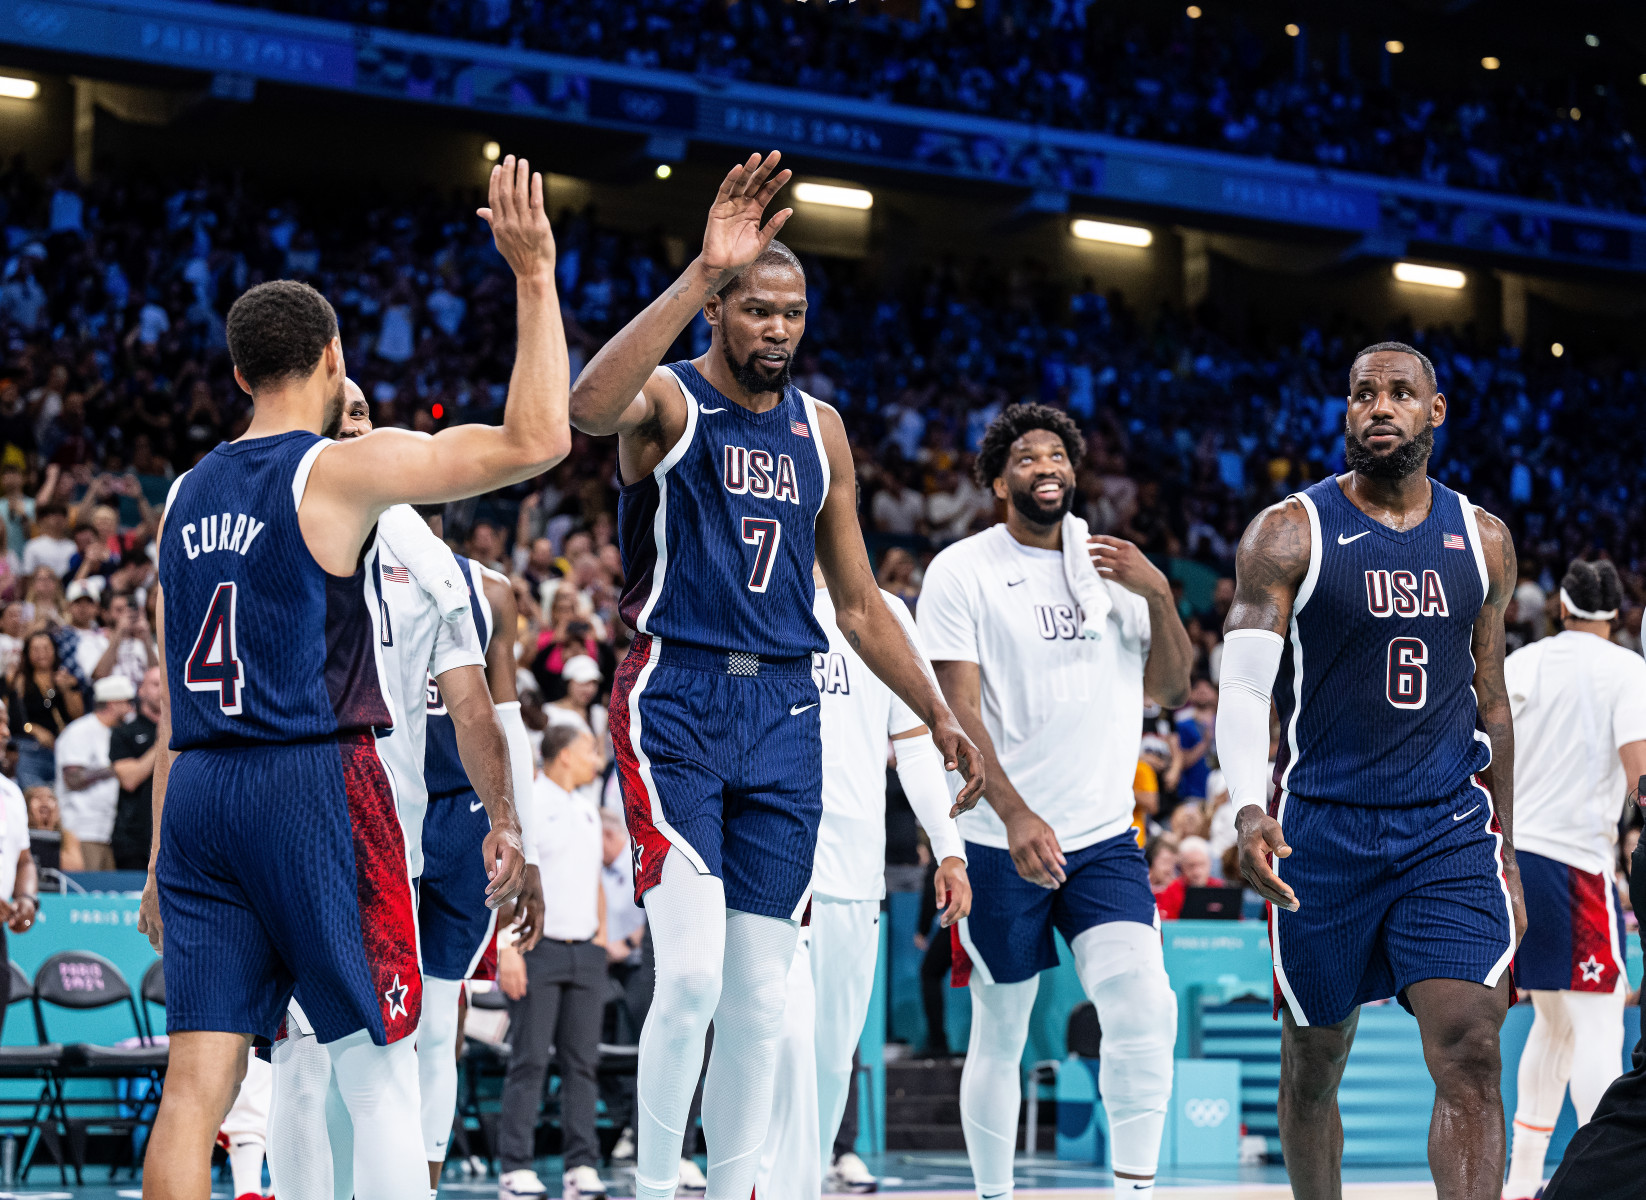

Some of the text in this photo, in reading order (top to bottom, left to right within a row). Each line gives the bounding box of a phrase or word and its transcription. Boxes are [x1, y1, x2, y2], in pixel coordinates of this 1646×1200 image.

[140, 22, 324, 71] PARIS 2024
[725, 106, 883, 151] PARIS 2024
[724, 444, 800, 506] USA
[181, 512, 265, 560] CURRY
[741, 516, 782, 594] 7
[1364, 569, 1450, 618] USA
[184, 581, 245, 716] 4
[811, 651, 850, 696] SA
[1385, 636, 1429, 710] 6
[70, 908, 120, 926] PARIS
[59, 962, 103, 978] PARIS
[62, 975, 105, 991] 2024
